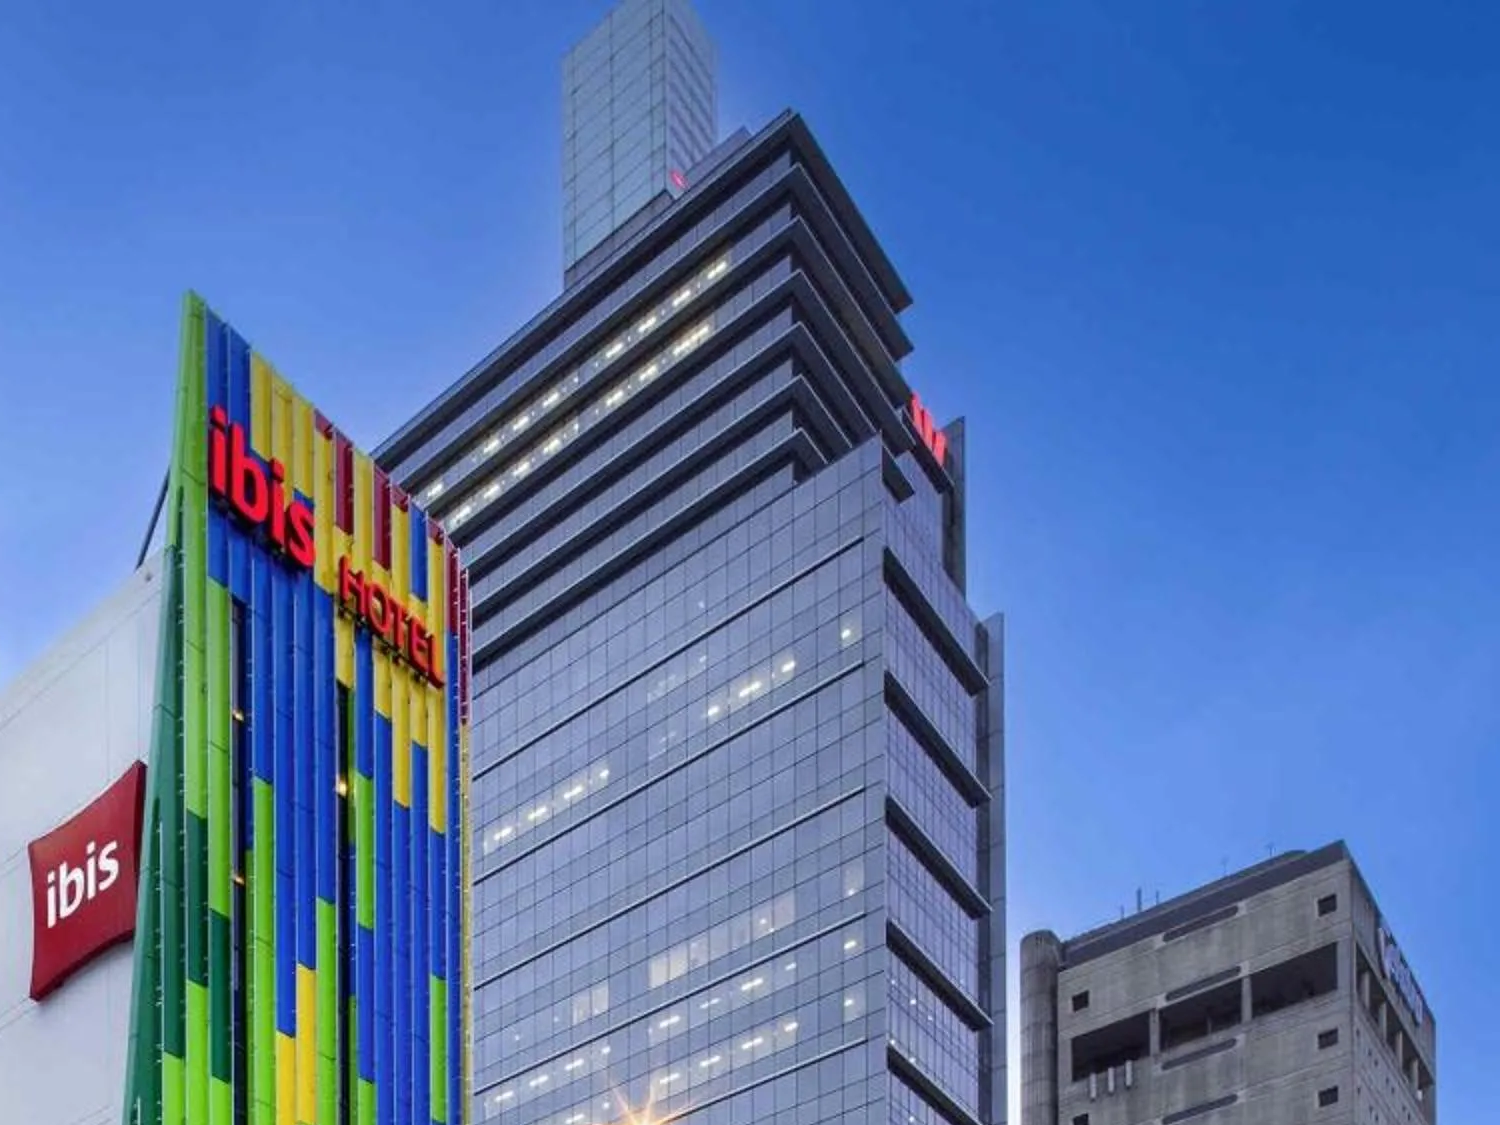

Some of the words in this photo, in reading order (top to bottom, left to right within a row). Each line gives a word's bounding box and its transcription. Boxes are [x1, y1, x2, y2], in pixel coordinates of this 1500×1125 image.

[208, 404, 316, 568] ibis
[338, 554, 445, 688] HOTEL
[46, 840, 120, 929] ibis
